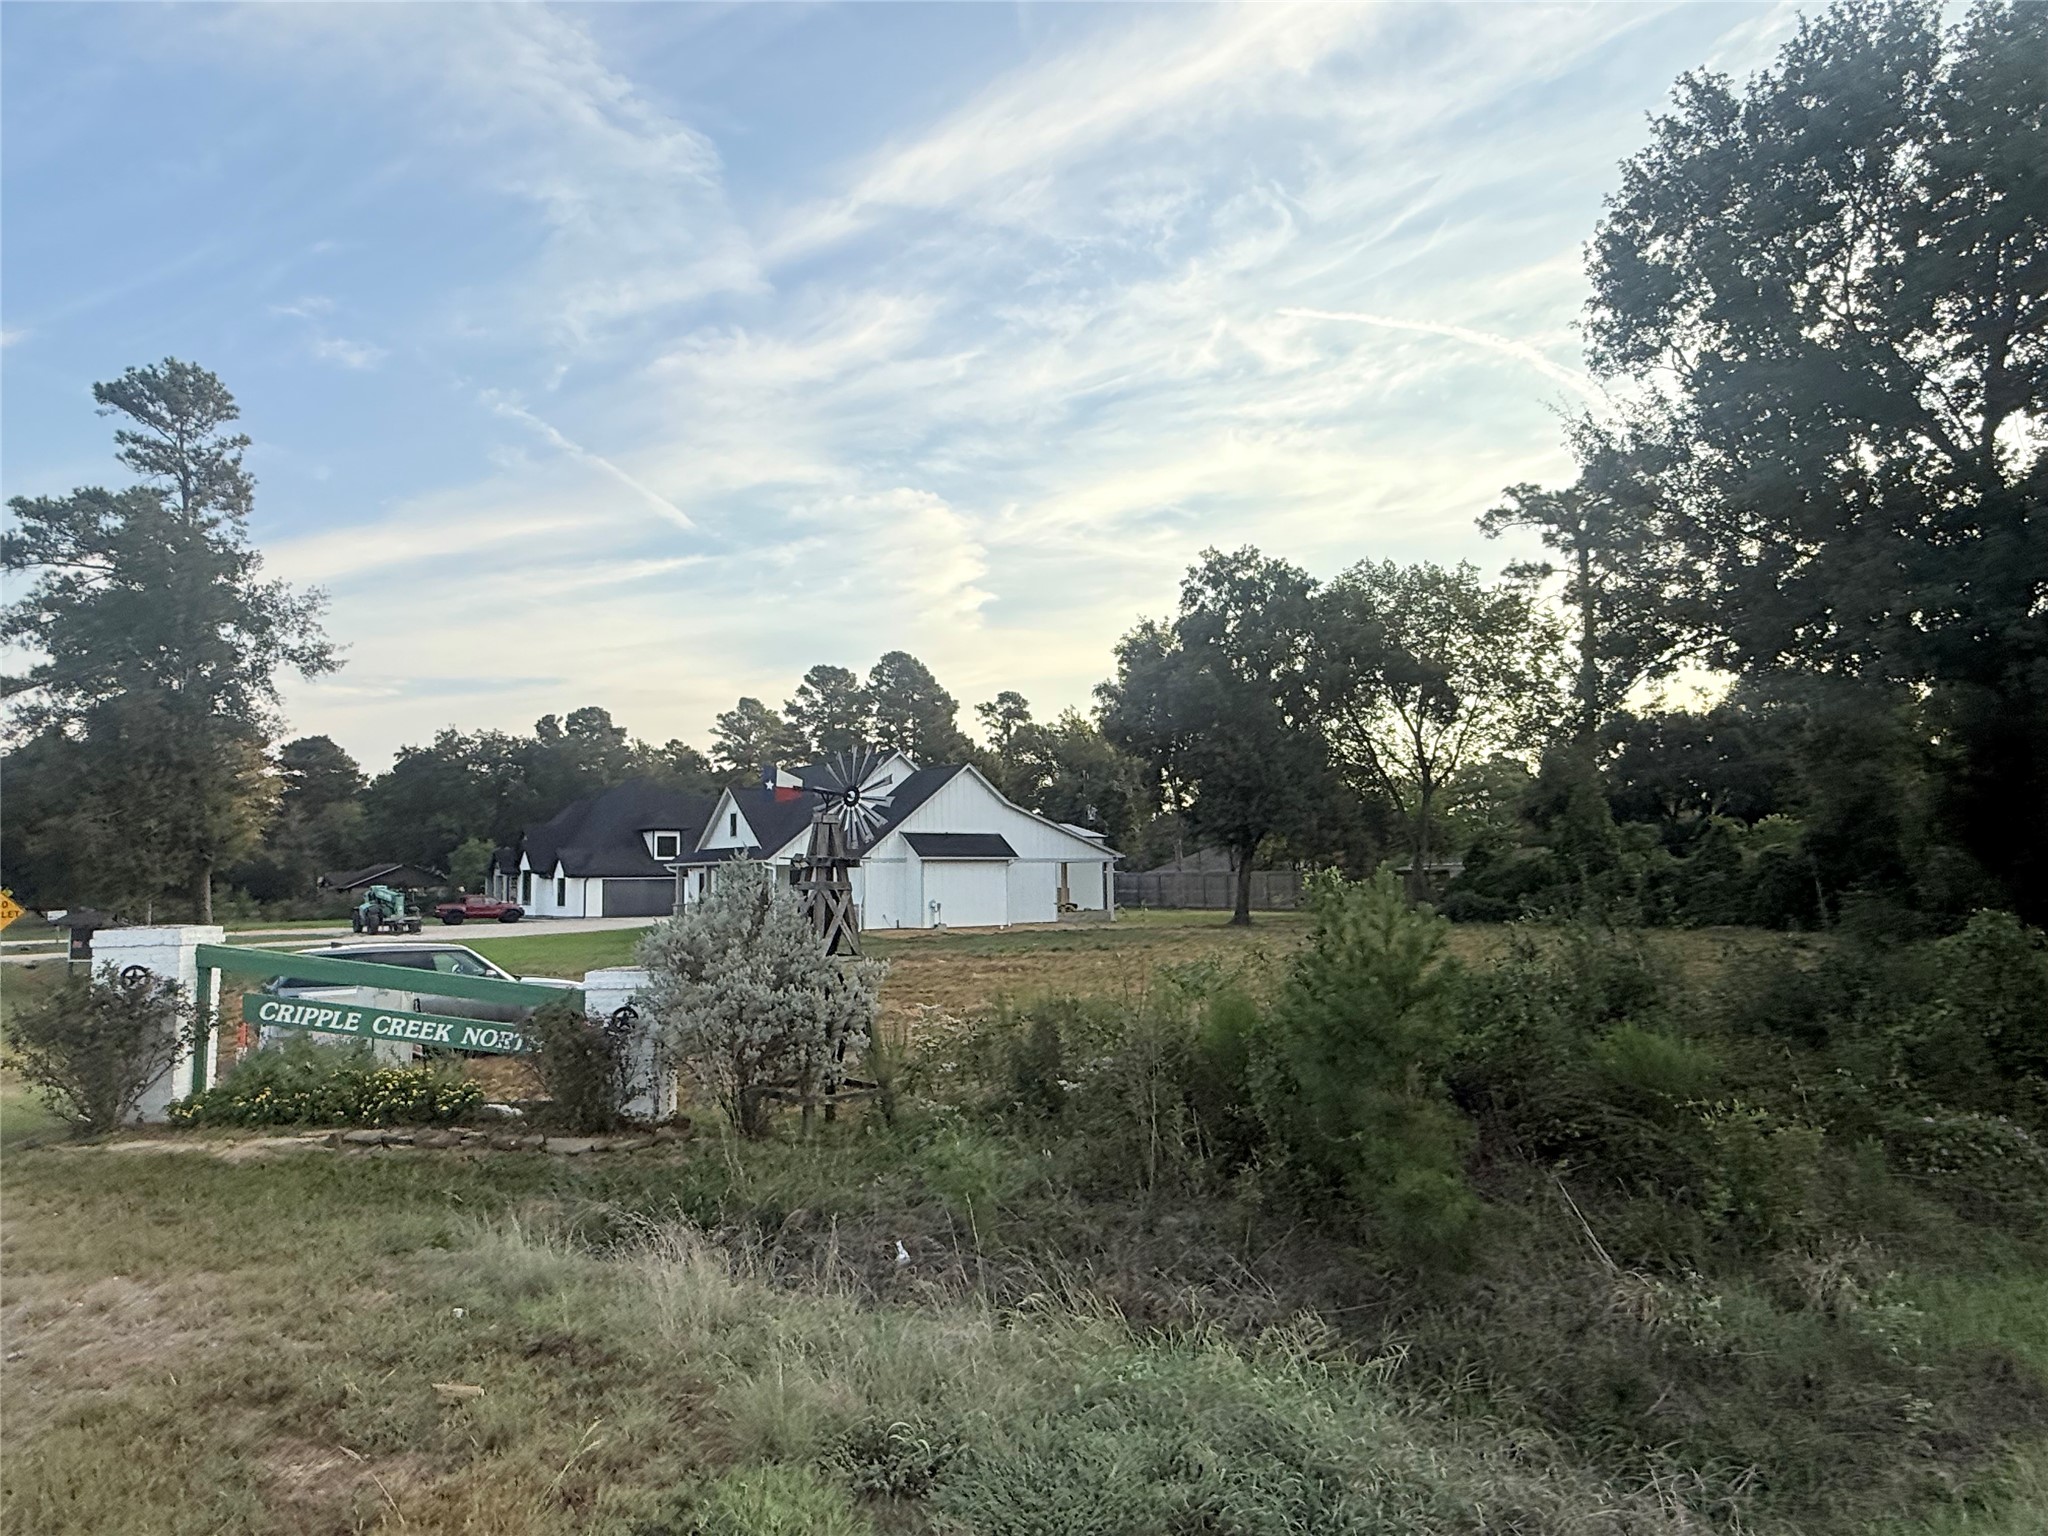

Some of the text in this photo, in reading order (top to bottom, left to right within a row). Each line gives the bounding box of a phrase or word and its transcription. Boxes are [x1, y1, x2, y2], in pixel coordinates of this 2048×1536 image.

[1, 910, 20, 919] LET
[259, 1002, 544, 1053] CRIPPLE CREEK NORT
